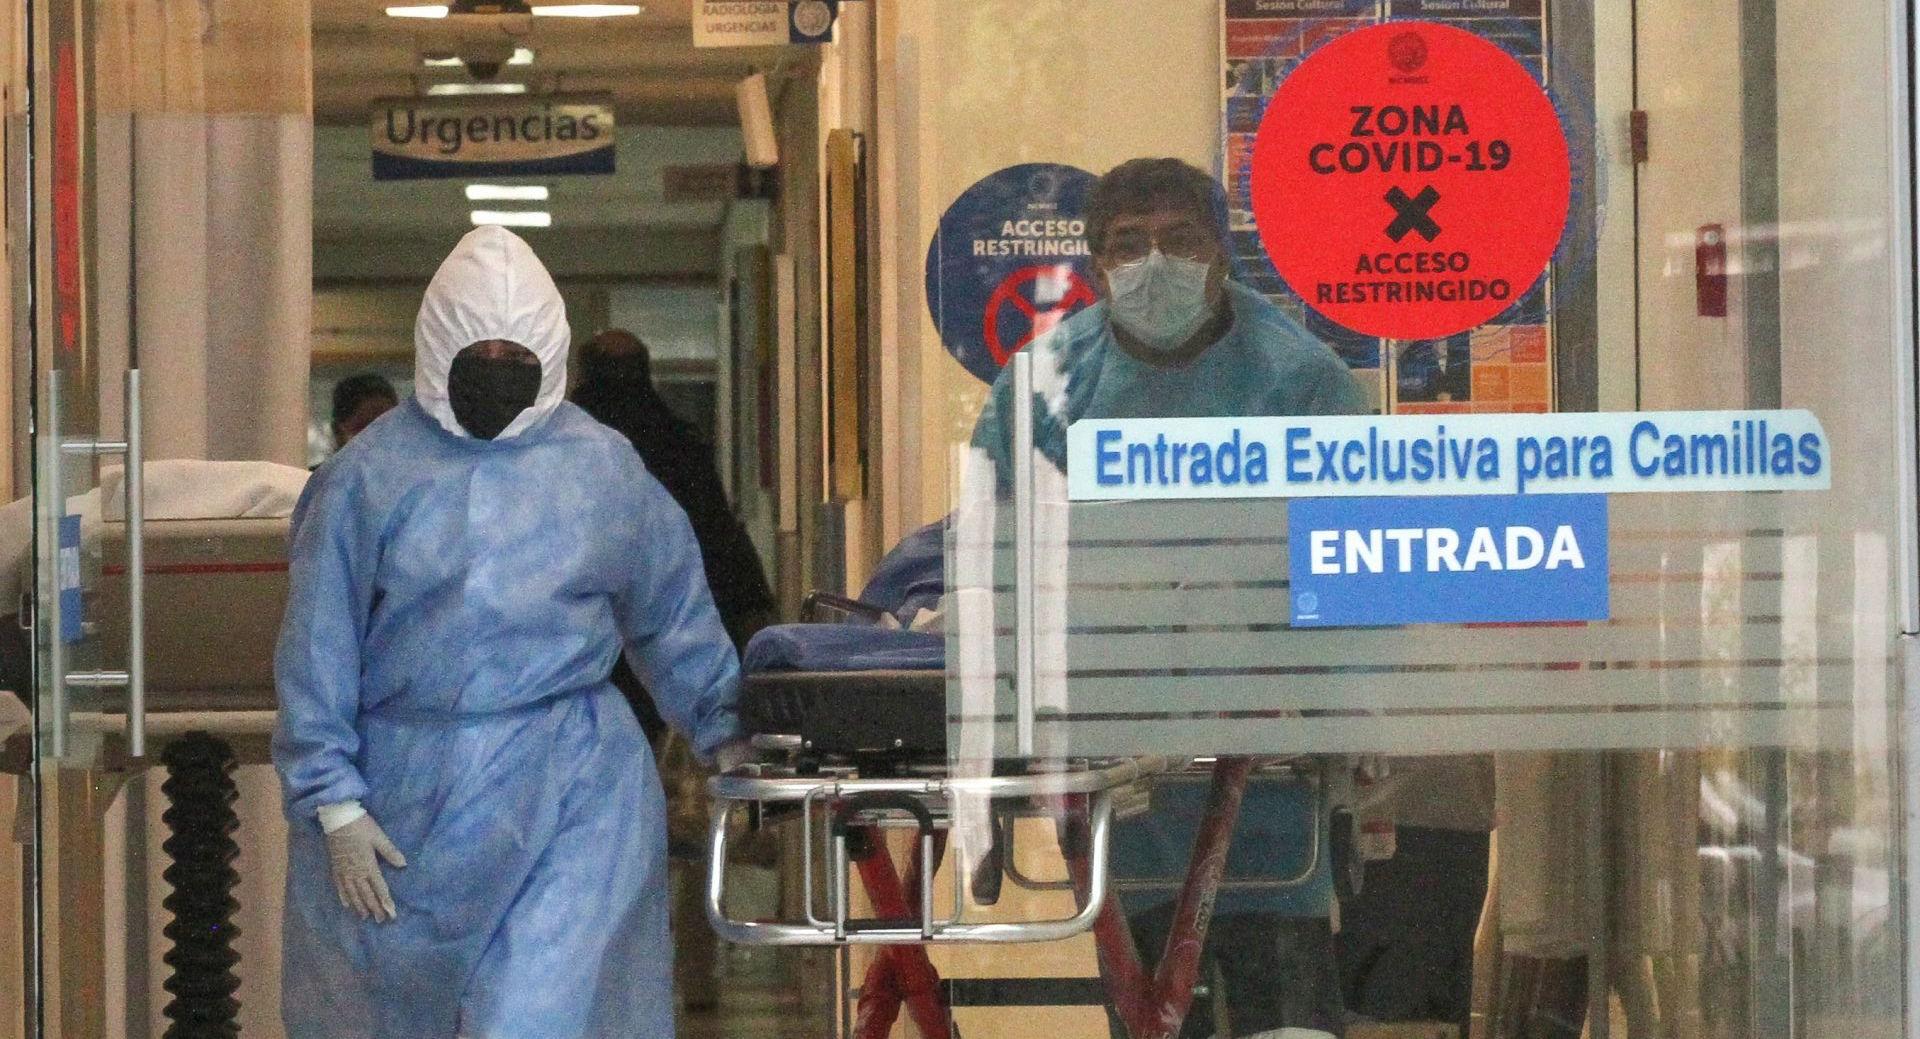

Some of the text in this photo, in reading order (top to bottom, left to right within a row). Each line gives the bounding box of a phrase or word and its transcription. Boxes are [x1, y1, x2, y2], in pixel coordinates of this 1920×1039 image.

[386, 106, 600, 154] Urgencias
[1350, 105, 1469, 137] ZONA
[1309, 139, 1511, 174] COVID-19
[1001, 219, 1085, 237] ACCESO
[1356, 252, 1469, 274] ACCESO
[1316, 279, 1511, 304] RESTRINGIDO
[1096, 419, 1822, 495] Entrada Exclusiva para Camillas
[1310, 525, 1585, 575] ENTRADA
